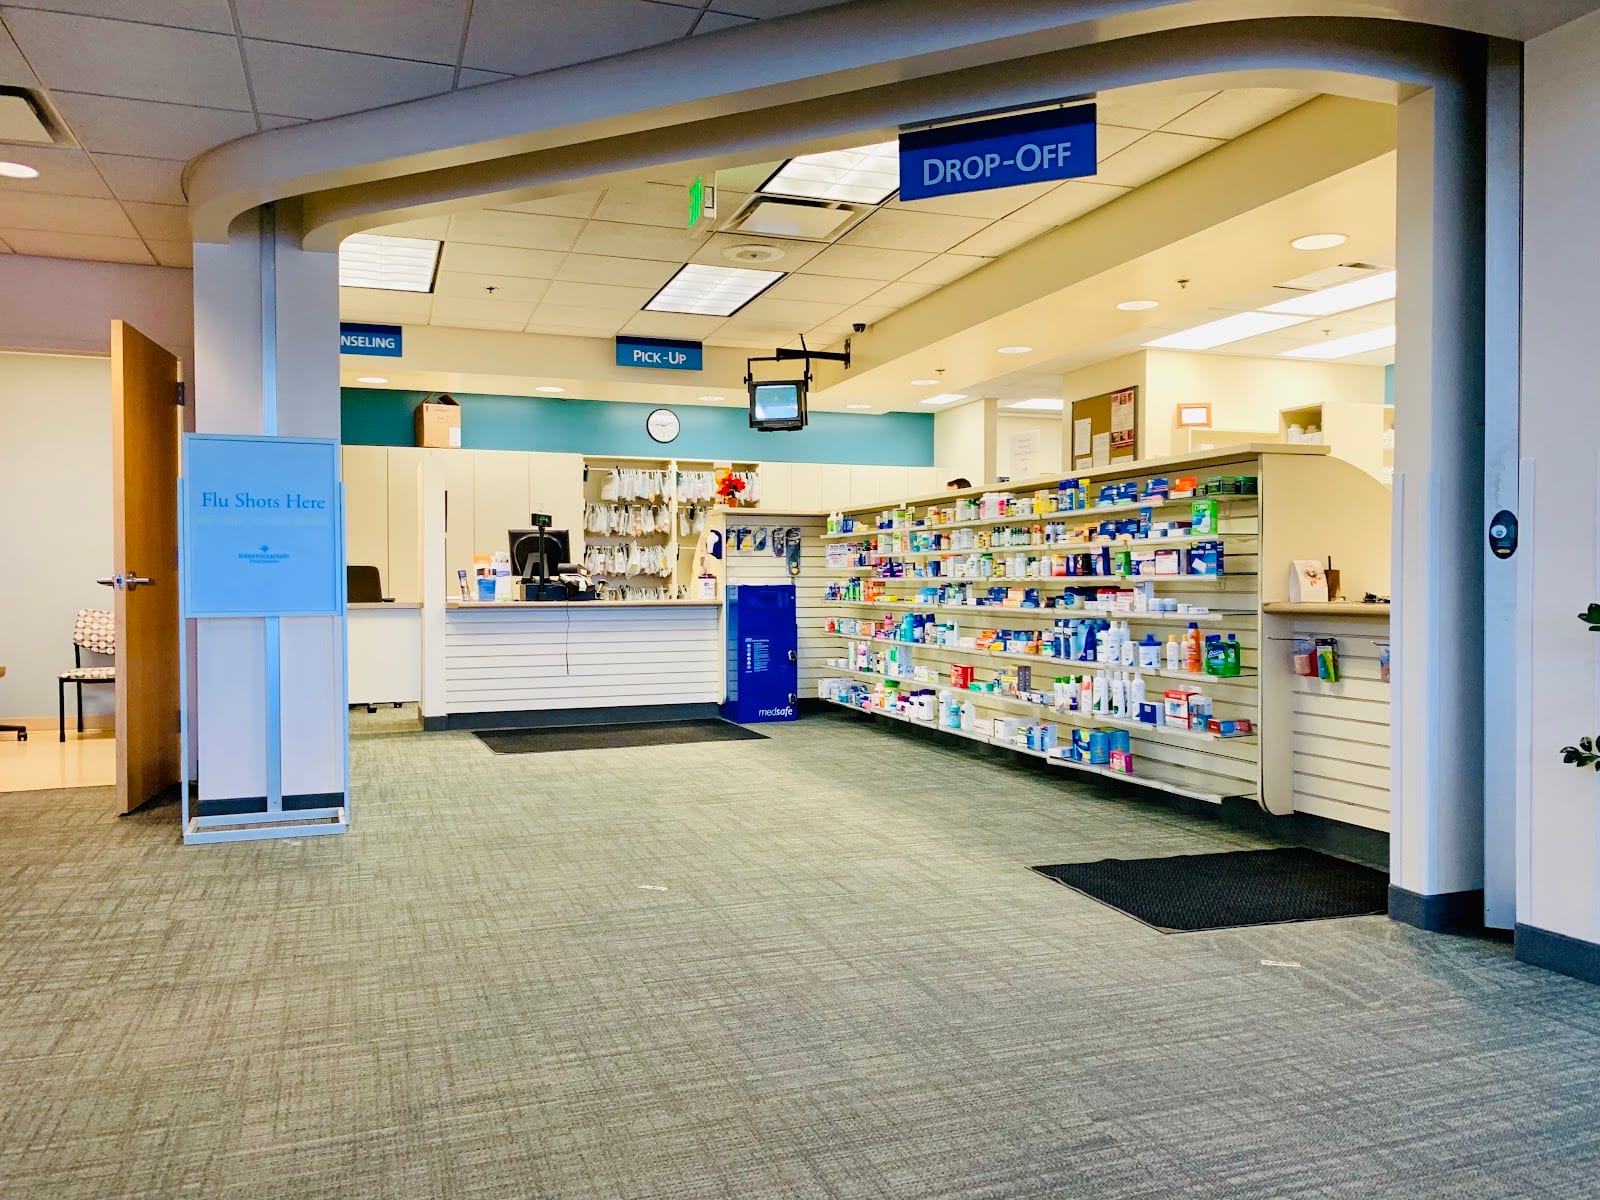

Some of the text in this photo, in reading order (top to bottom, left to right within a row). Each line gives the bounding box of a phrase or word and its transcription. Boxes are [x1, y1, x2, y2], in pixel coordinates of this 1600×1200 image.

[923, 142, 1071, 186] DROP-OFF
[340, 335, 395, 349] NSELING
[633, 349, 687, 364] PICK-UP
[201, 491, 326, 509] Flu Shots Here
[758, 706, 793, 717] medsafe
